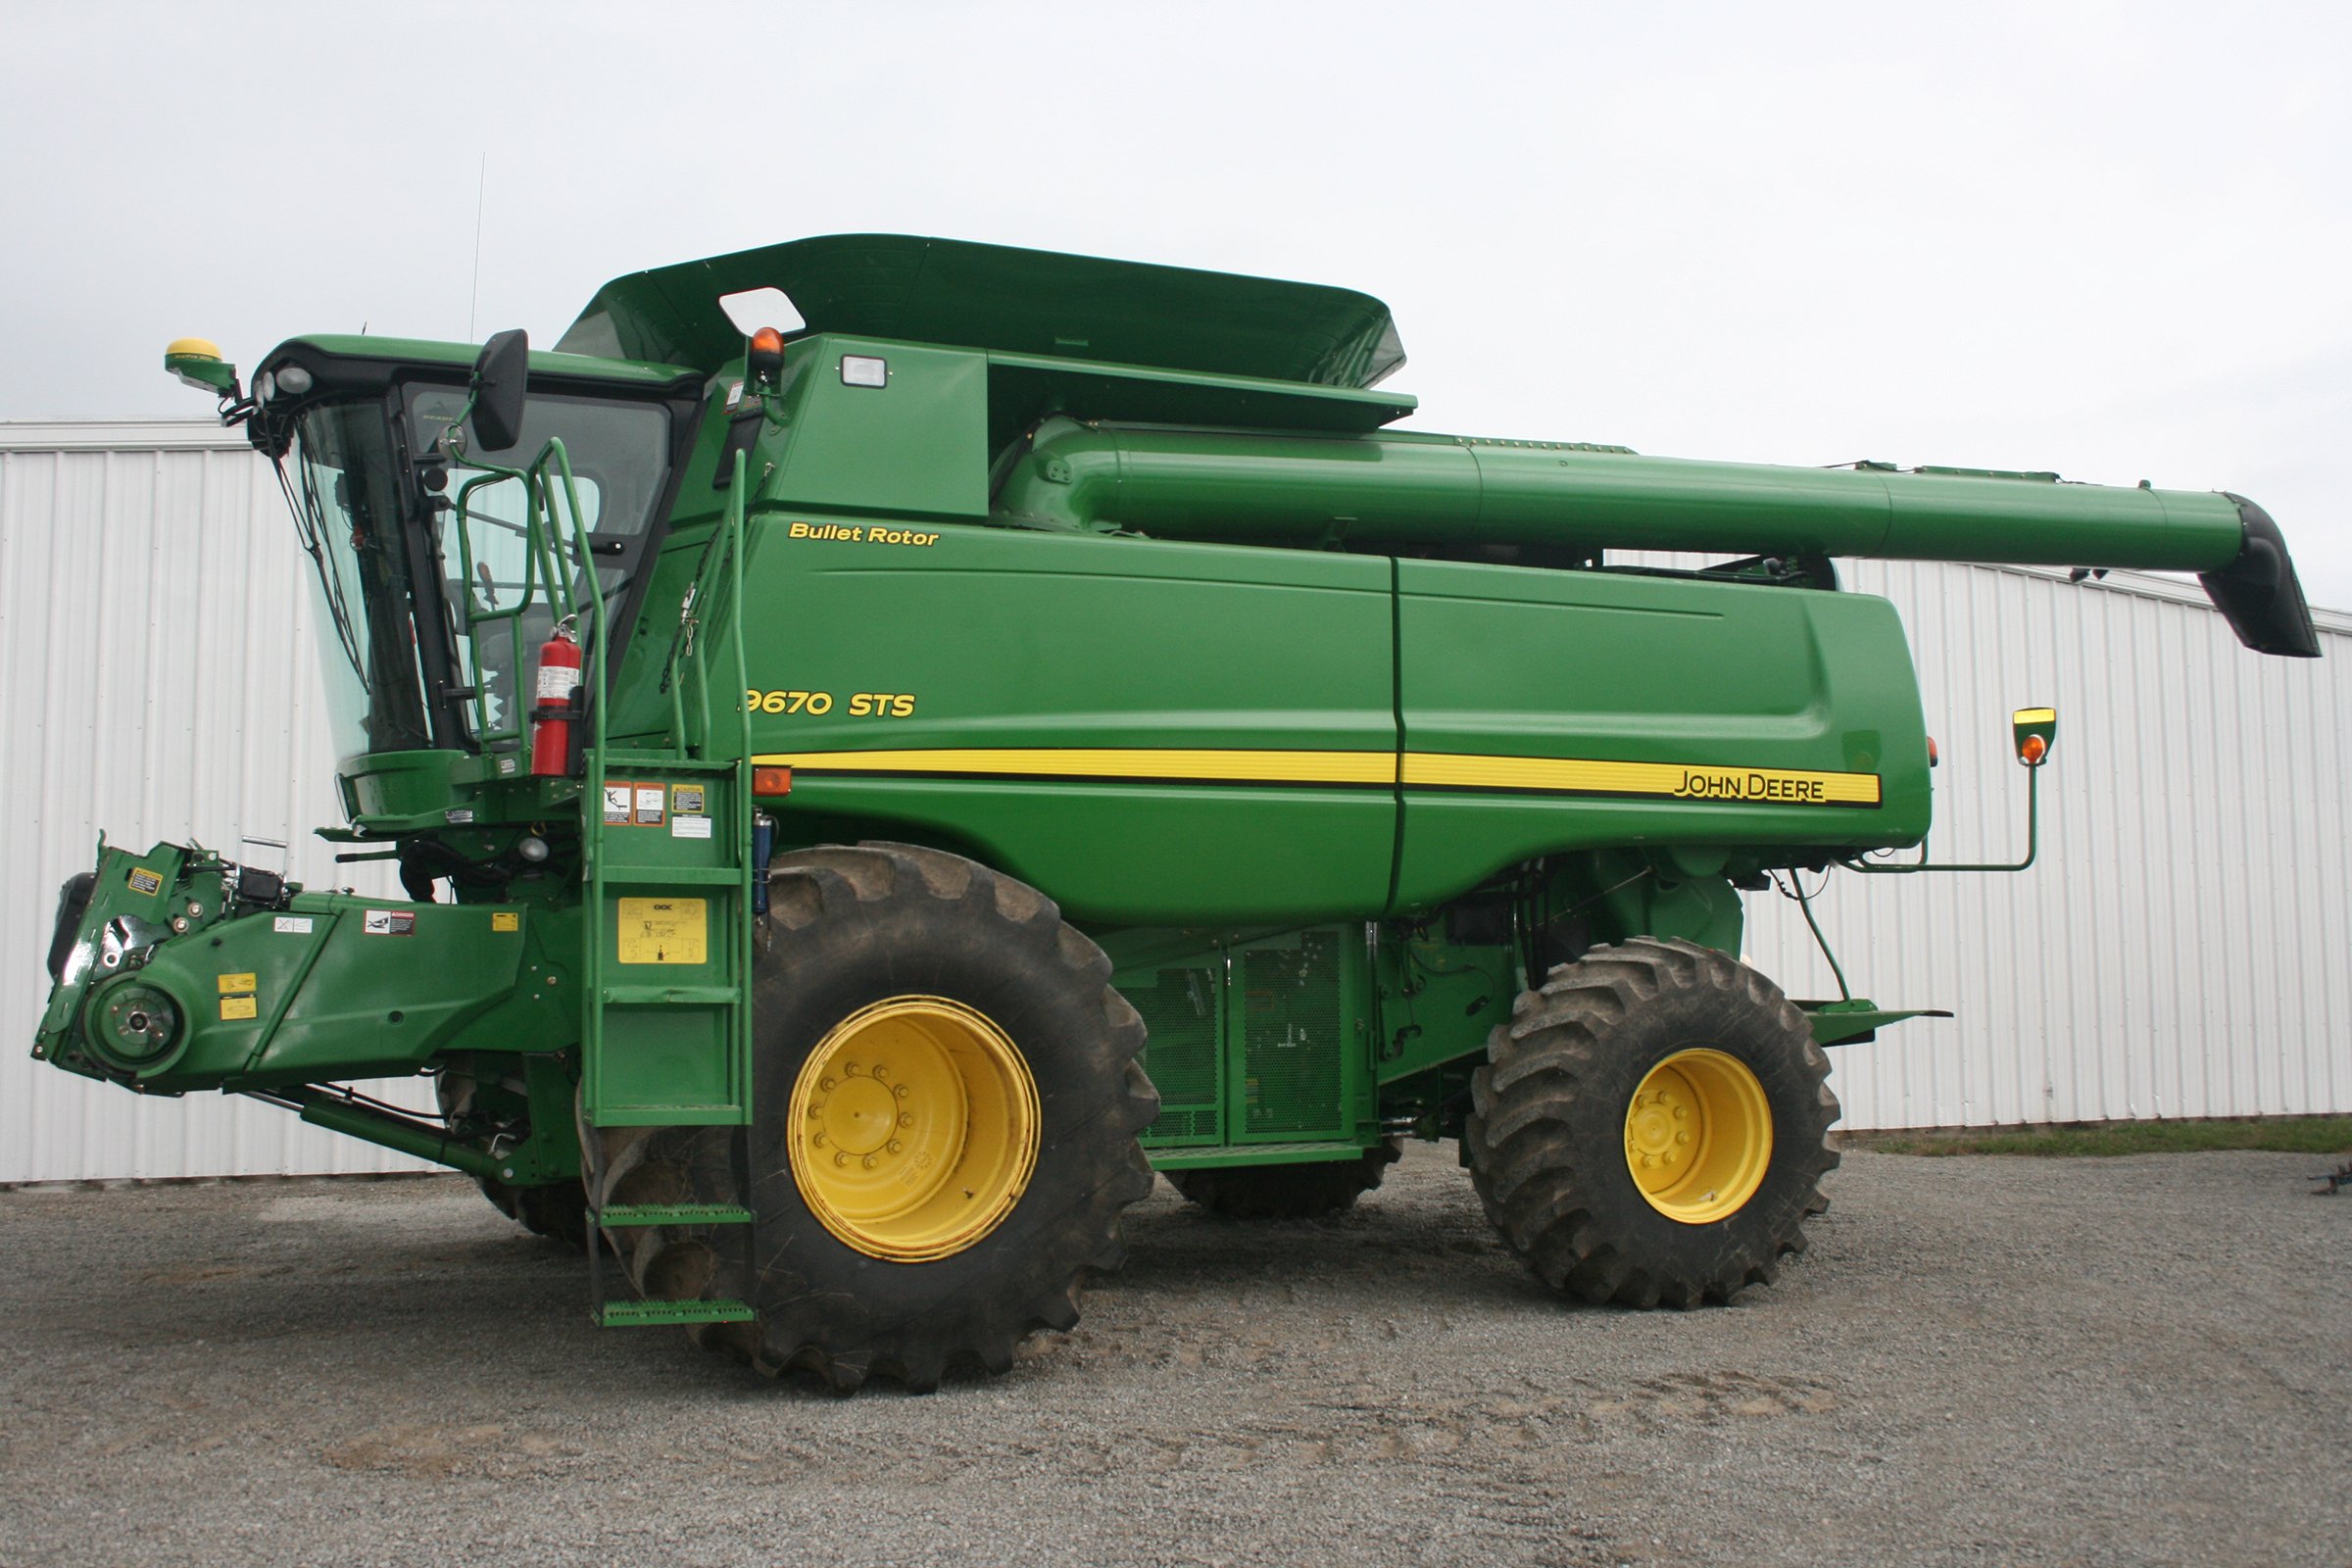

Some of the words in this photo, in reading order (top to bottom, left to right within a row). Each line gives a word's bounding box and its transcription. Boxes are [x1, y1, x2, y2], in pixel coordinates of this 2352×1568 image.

[788, 521, 863, 542] Bullet
[867, 526, 940, 547] Rotor
[738, 689, 833, 715] 9670
[848, 692, 915, 717] STS
[1674, 770, 1741, 796] JOHN
[1747, 773, 1824, 799] DEERE
